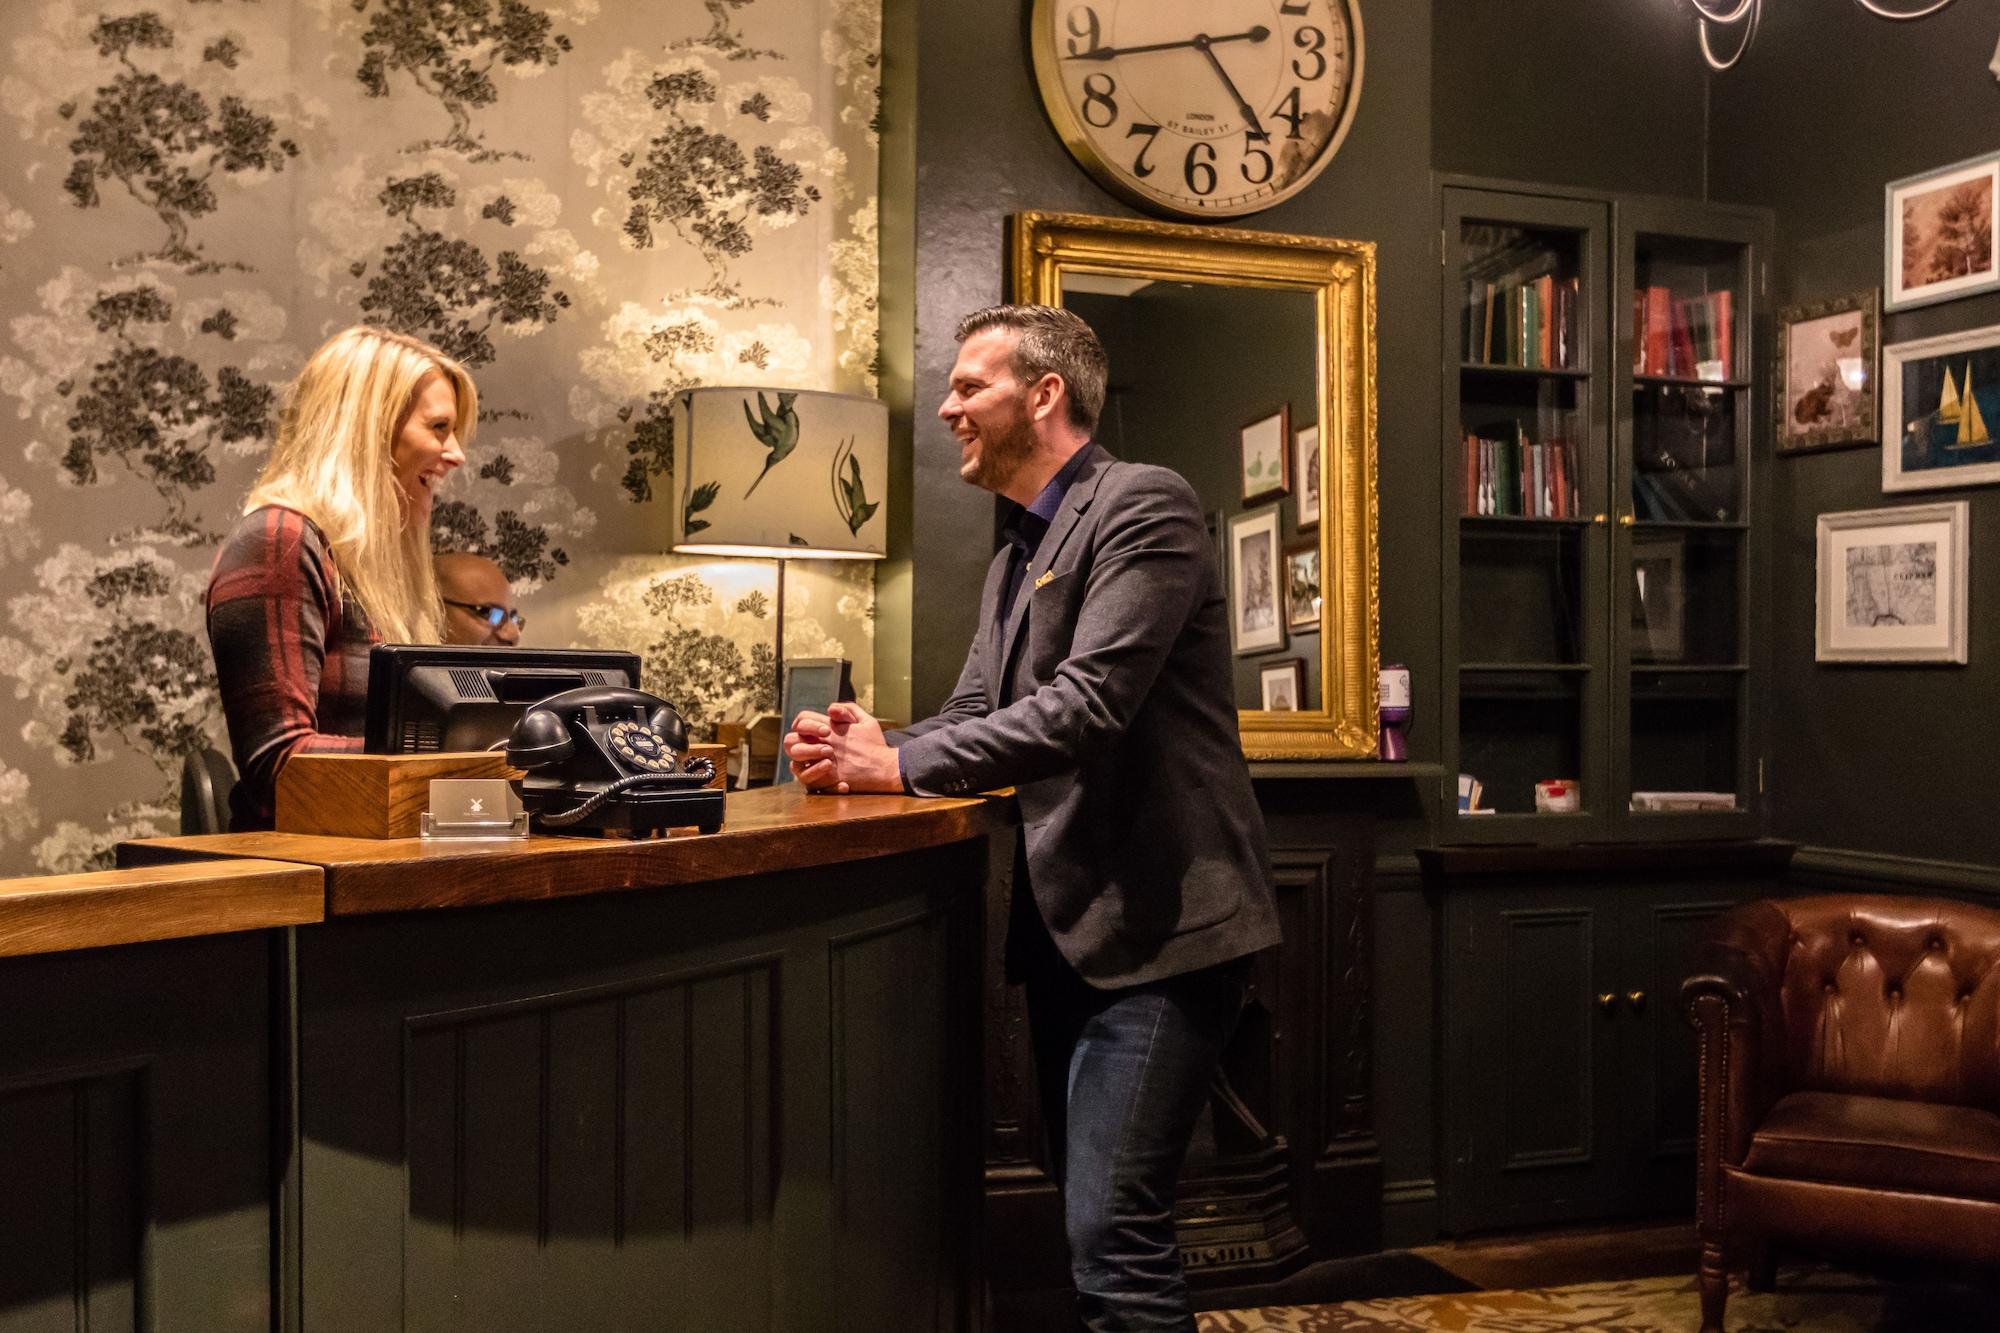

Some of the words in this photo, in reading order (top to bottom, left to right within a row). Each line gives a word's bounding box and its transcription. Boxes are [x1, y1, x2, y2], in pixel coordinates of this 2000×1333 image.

[1066, 5, 1100, 56] 9
[1292, 26, 1326, 81] 3
[1082, 72, 1118, 128] 8
[1185, 113, 1215, 121] LONDON
[1269, 86, 1309, 140] 4
[1126, 122, 1162, 178] 7
[1183, 142, 1217, 195] 6
[1240, 130, 1274, 184] 5
